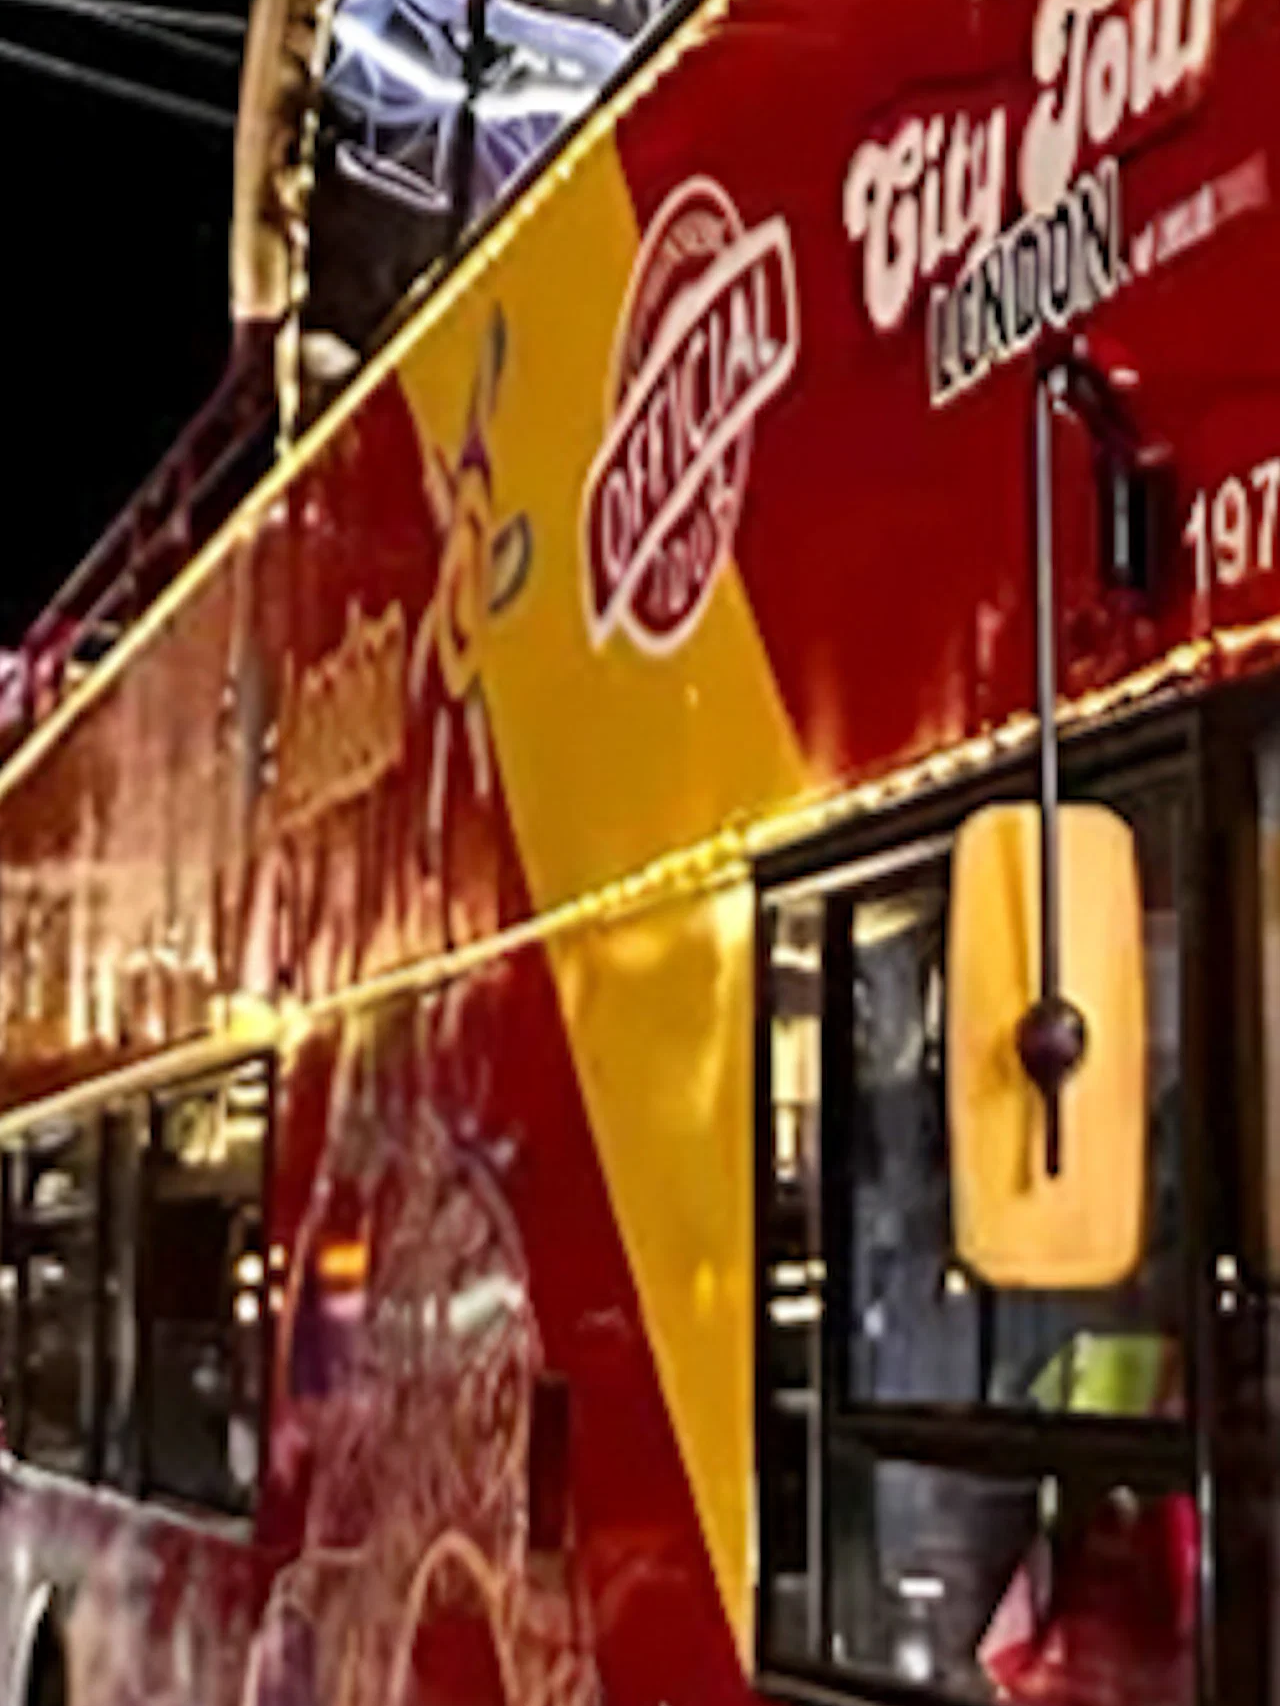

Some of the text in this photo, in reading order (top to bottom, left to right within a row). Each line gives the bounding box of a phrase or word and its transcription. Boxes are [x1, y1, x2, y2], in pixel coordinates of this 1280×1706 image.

[842, 105, 1007, 329] City
[924, 155, 1122, 411] LONDON
[601, 261, 782, 591] OFFICIAL
